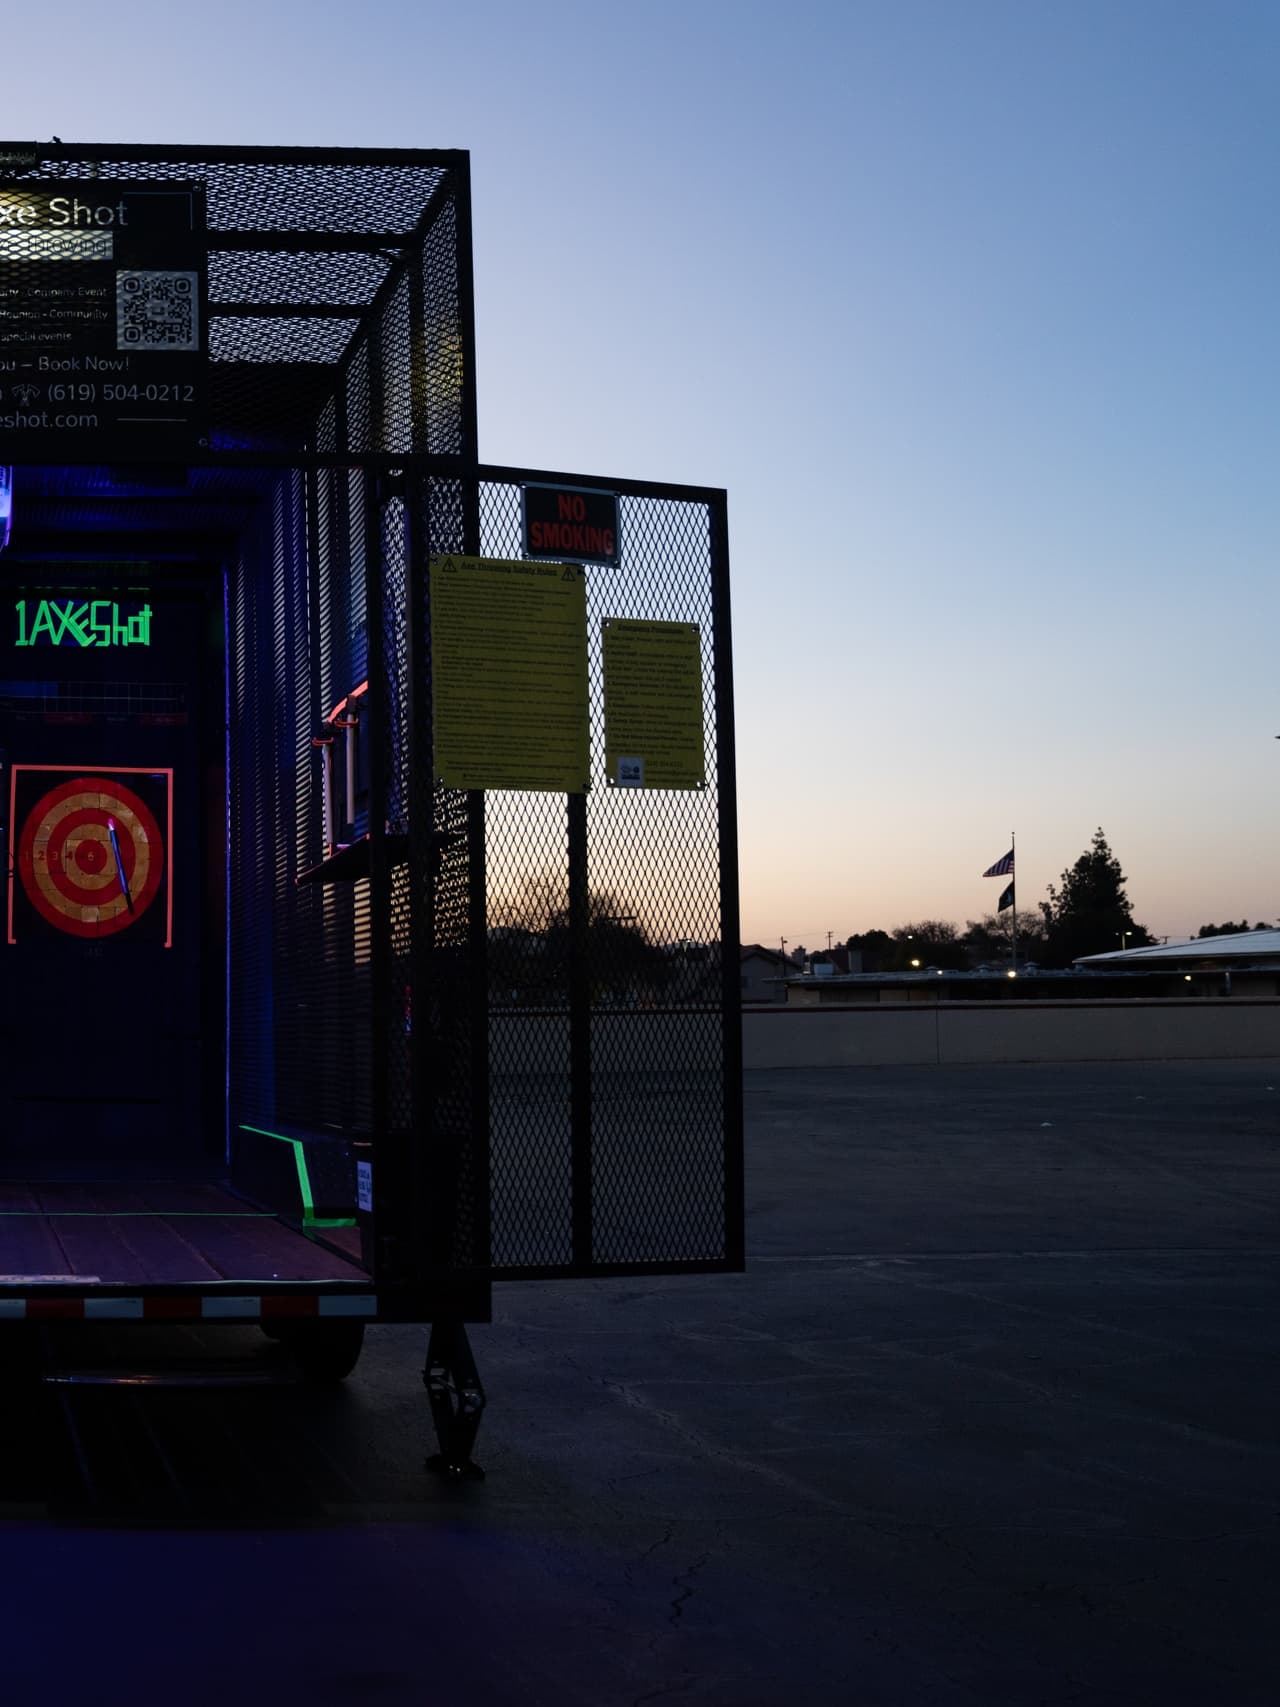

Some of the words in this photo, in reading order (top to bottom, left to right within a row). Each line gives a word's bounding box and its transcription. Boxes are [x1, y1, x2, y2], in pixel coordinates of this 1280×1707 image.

[49, 197, 129, 226] Shot
[78, 286, 107, 296] Event
[49, 308, 109, 320] Community
[38, 356, 81, 371] Book
[85, 356, 130, 371] Now!
[47, 383, 97, 404] (619)
[103, 384, 194, 402] 504-0212
[557, 494, 585, 522] NO
[530, 520, 615, 556] SMOKING
